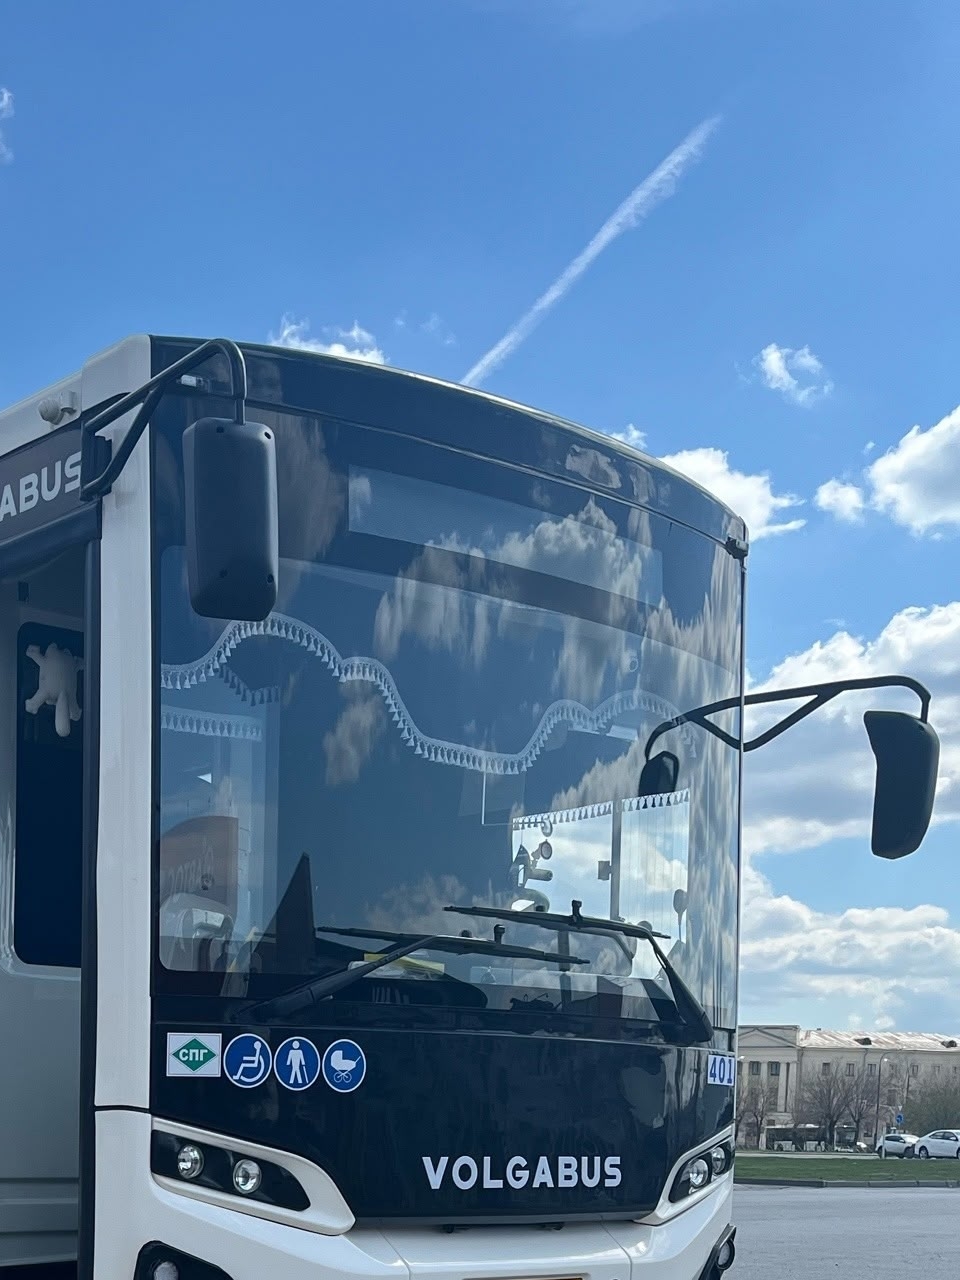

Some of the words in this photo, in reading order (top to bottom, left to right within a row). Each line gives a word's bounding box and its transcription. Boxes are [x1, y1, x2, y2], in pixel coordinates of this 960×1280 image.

[178, 1048, 209, 1062] СПГ
[709, 1056, 733, 1084] 401
[421, 1155, 622, 1190] VOLGABUS
